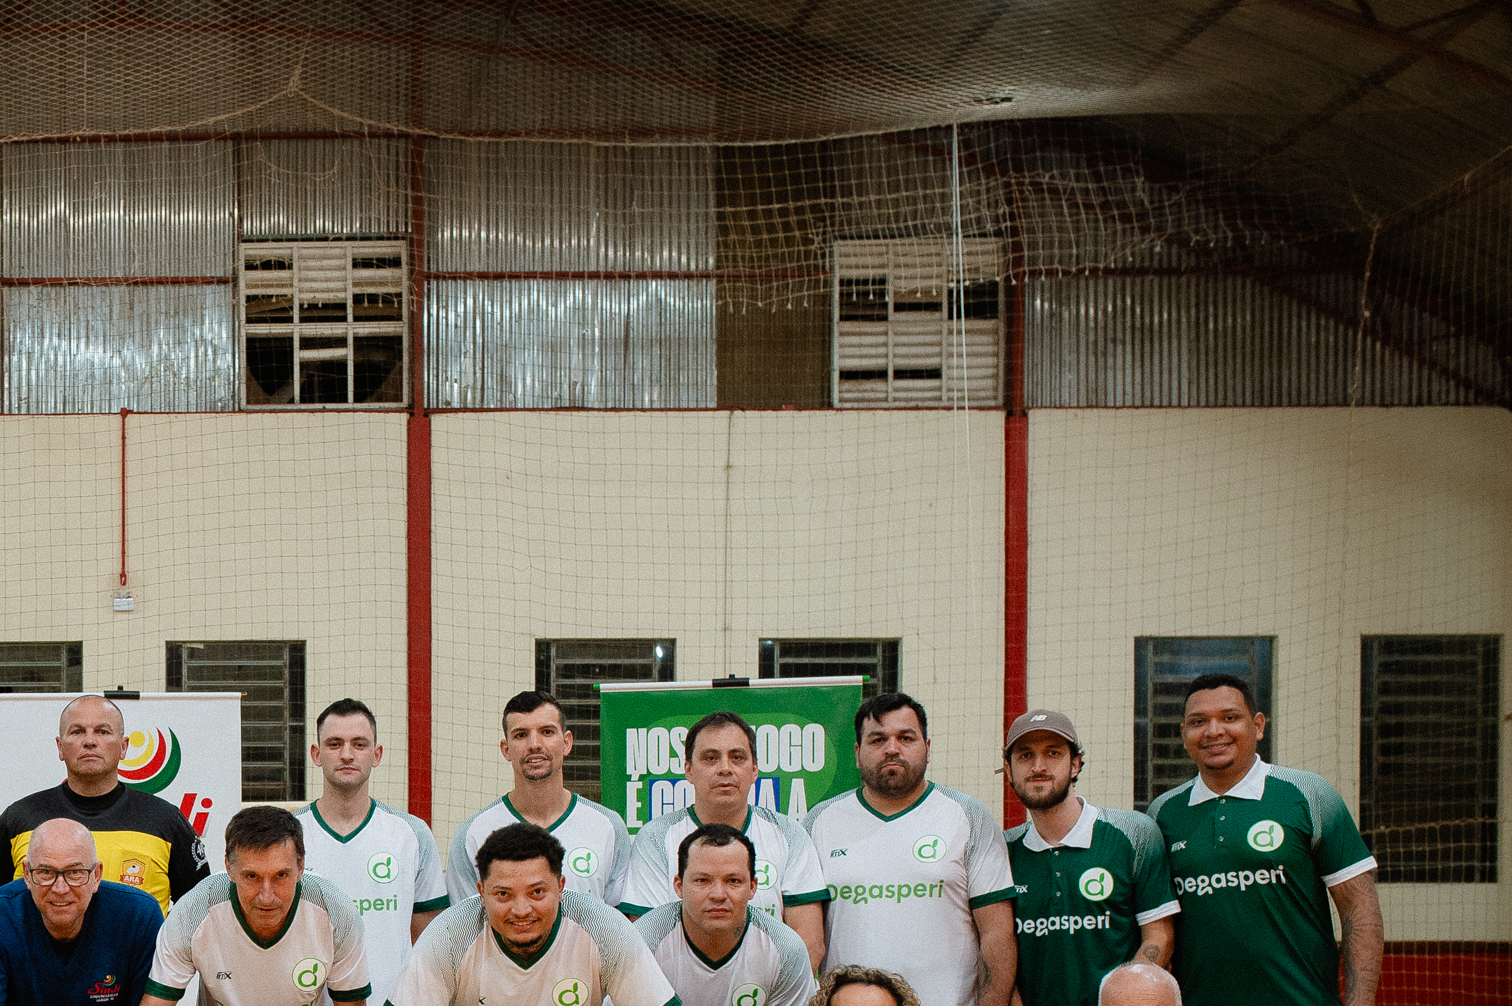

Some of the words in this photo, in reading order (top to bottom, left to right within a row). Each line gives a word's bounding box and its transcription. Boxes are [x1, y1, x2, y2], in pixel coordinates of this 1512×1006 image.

[754, 723, 826, 773] OGO
[626, 774, 644, 828] É
[788, 778, 808, 823] A
[123, 875, 140, 883] ARA
